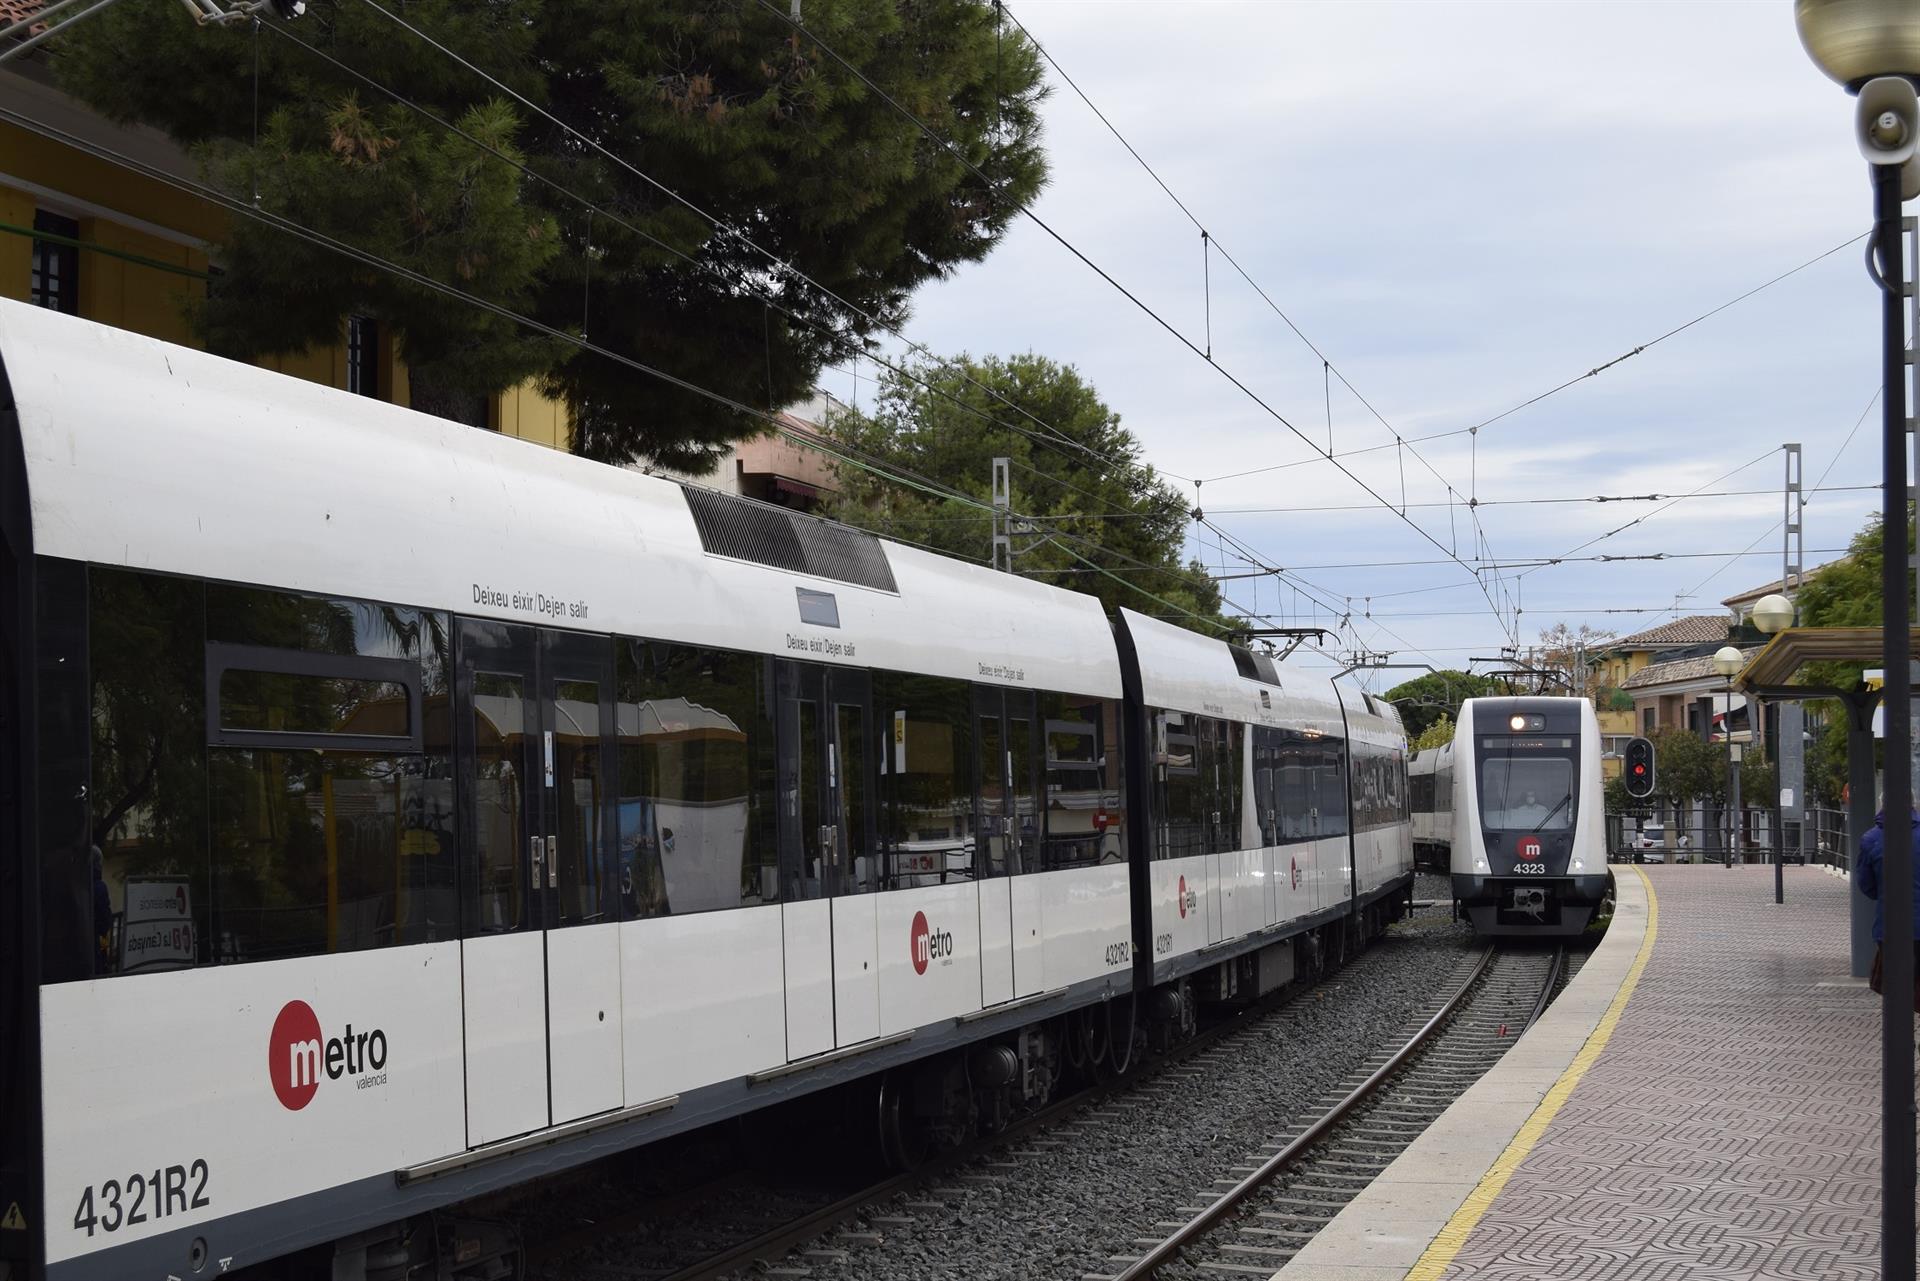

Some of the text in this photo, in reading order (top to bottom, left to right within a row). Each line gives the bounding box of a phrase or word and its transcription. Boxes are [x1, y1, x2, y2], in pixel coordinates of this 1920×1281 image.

[473, 584, 508, 608] Deixeu
[570, 600, 588, 619] salir
[786, 633, 808, 651] Deixeu
[1513, 863, 1545, 874] 4323
[917, 927, 952, 962] metro
[1105, 941, 1129, 966] 4321R2
[290, 1024, 387, 1088] metro
[356, 1072, 387, 1090] valencia
[74, 1158, 210, 1237] 4321R2
